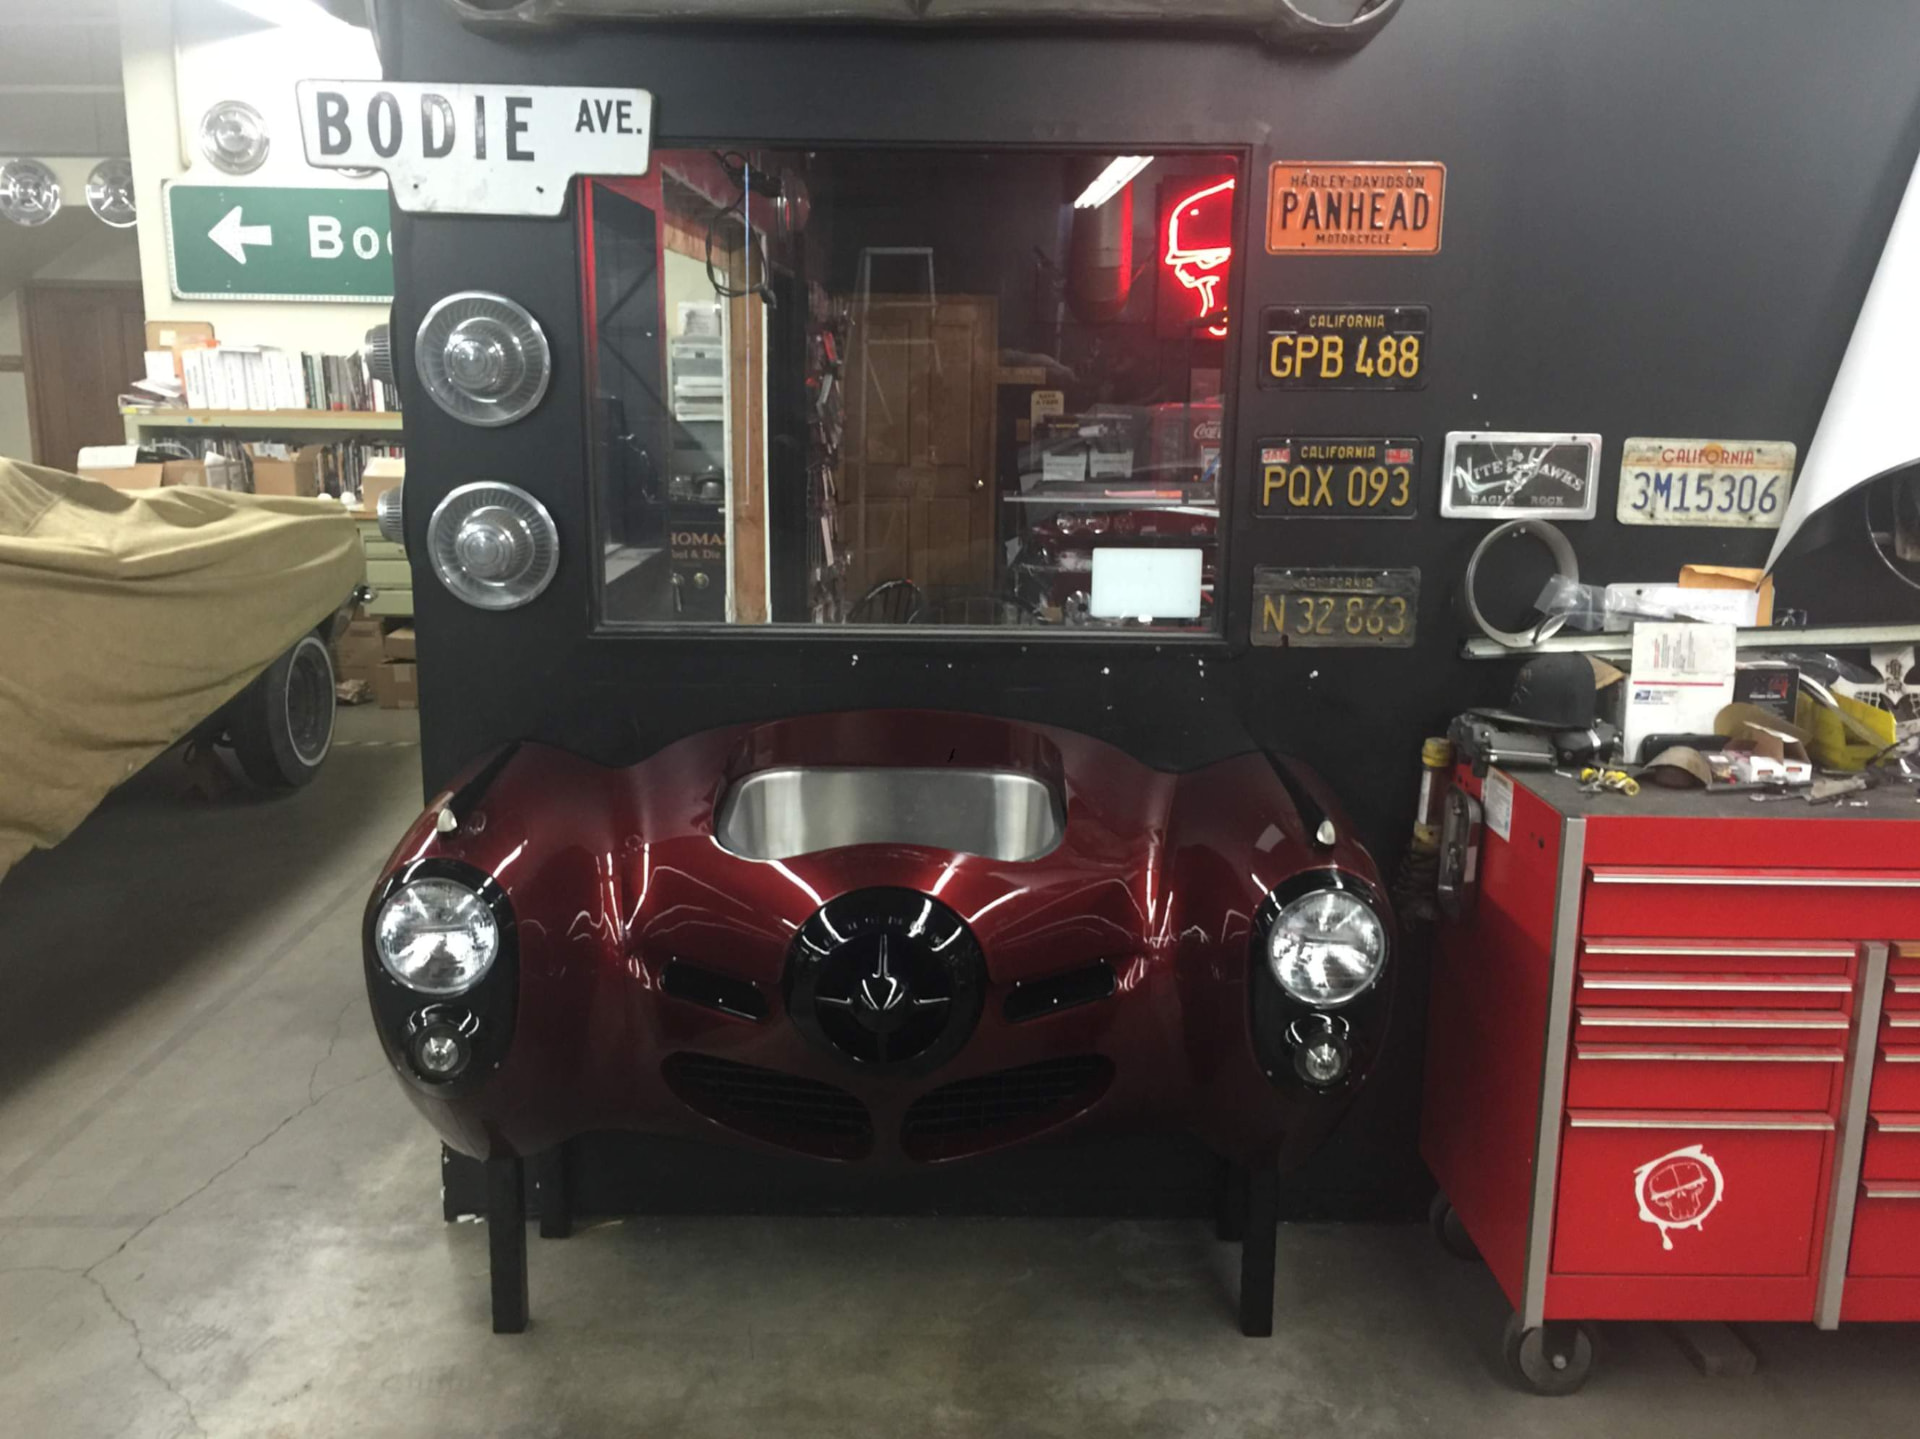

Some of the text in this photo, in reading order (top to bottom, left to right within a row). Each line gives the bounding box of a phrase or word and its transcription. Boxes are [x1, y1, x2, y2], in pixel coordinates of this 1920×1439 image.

[316, 91, 643, 162] BODIE AVE.
[1290, 174, 1425, 189] HARLEY-DAVIDSON
[1280, 190, 1431, 231] PANHEAD
[308, 214, 393, 260] Bo
[1315, 233, 1392, 245] MOTORCYCLE
[1308, 314, 1386, 328] CALIFORNIA
[1270, 335, 1420, 378] GPB 488
[1300, 446, 1377, 460] CALIFORNIA
[1660, 448, 1755, 465] CALIFORNIA
[1262, 465, 1411, 507] PQX 093
[1470, 493, 1565, 506] EAGLE ROCK
[1630, 471, 1780, 514] 3M15306
[1262, 594, 1407, 635] N 32 863
